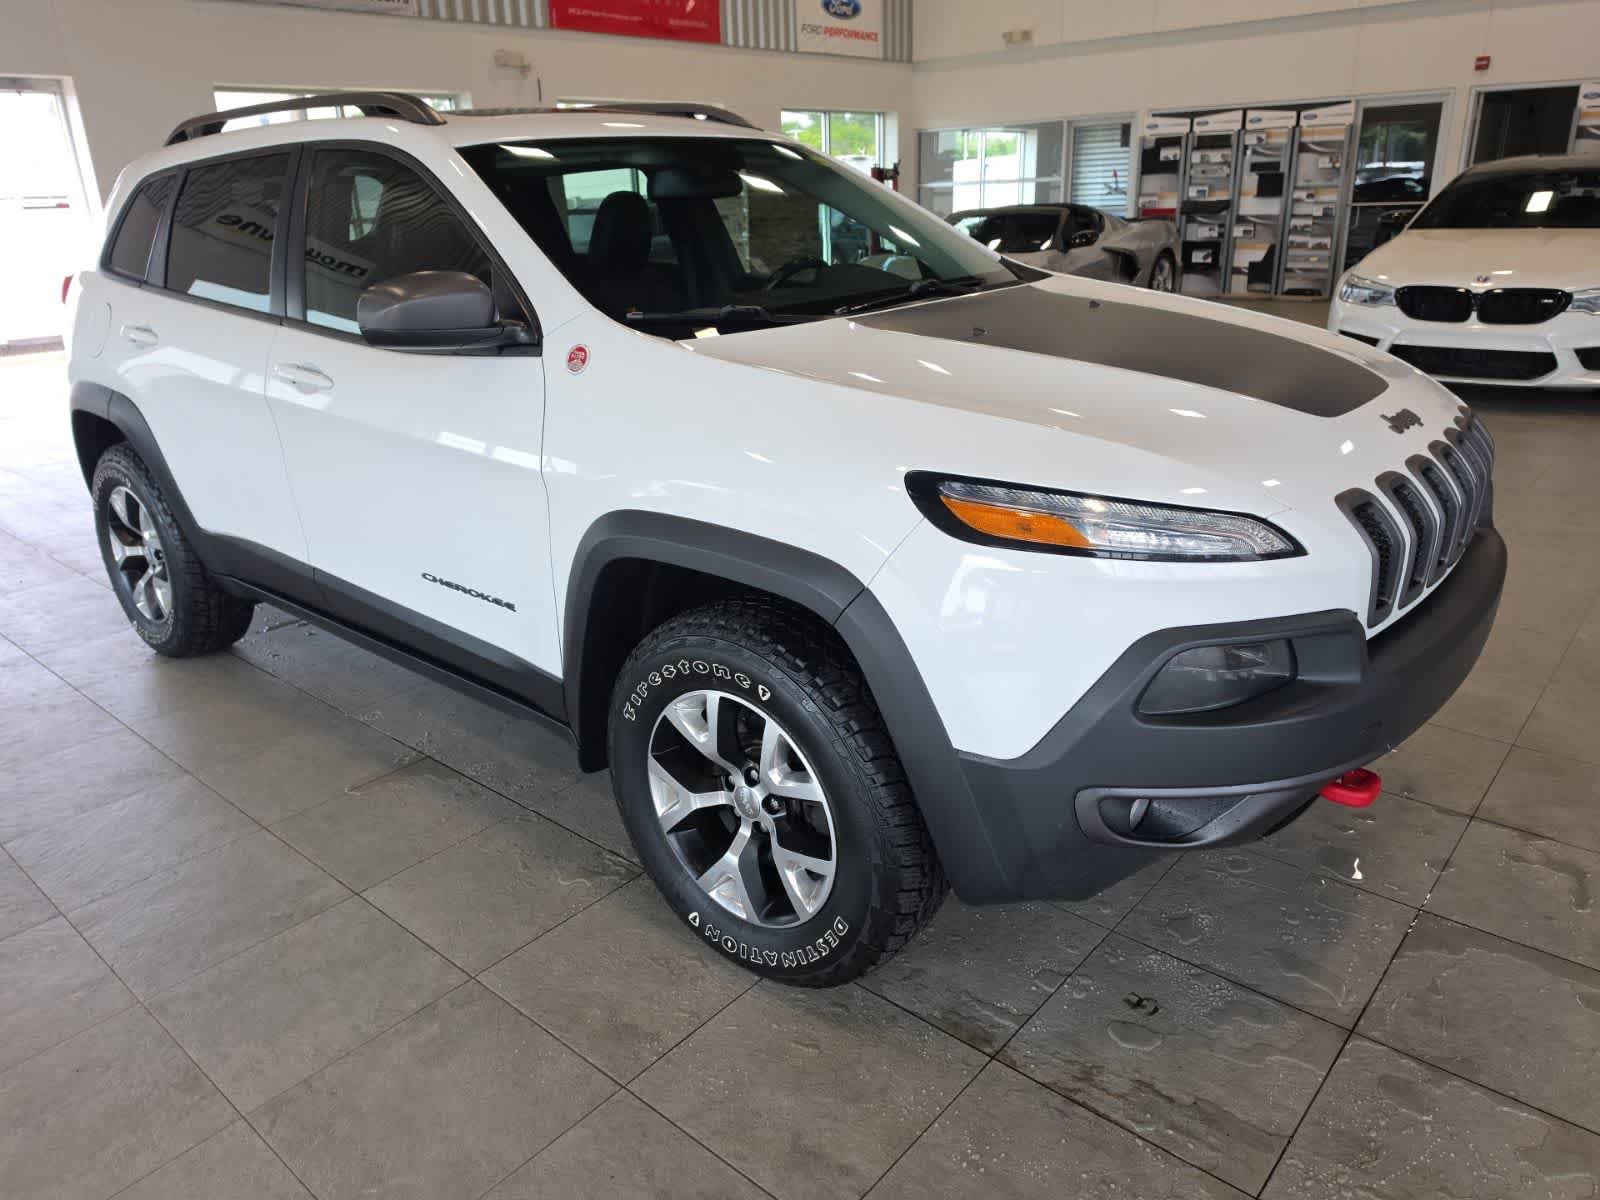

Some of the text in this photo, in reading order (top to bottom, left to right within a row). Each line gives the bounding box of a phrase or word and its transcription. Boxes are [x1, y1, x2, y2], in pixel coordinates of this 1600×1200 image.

[801, 23, 879, 42] FORD PERFORMANCE
[421, 572, 516, 612] CHEROKEE
[624, 659, 751, 721] Firestone
[705, 915, 849, 968] DESTINATION
